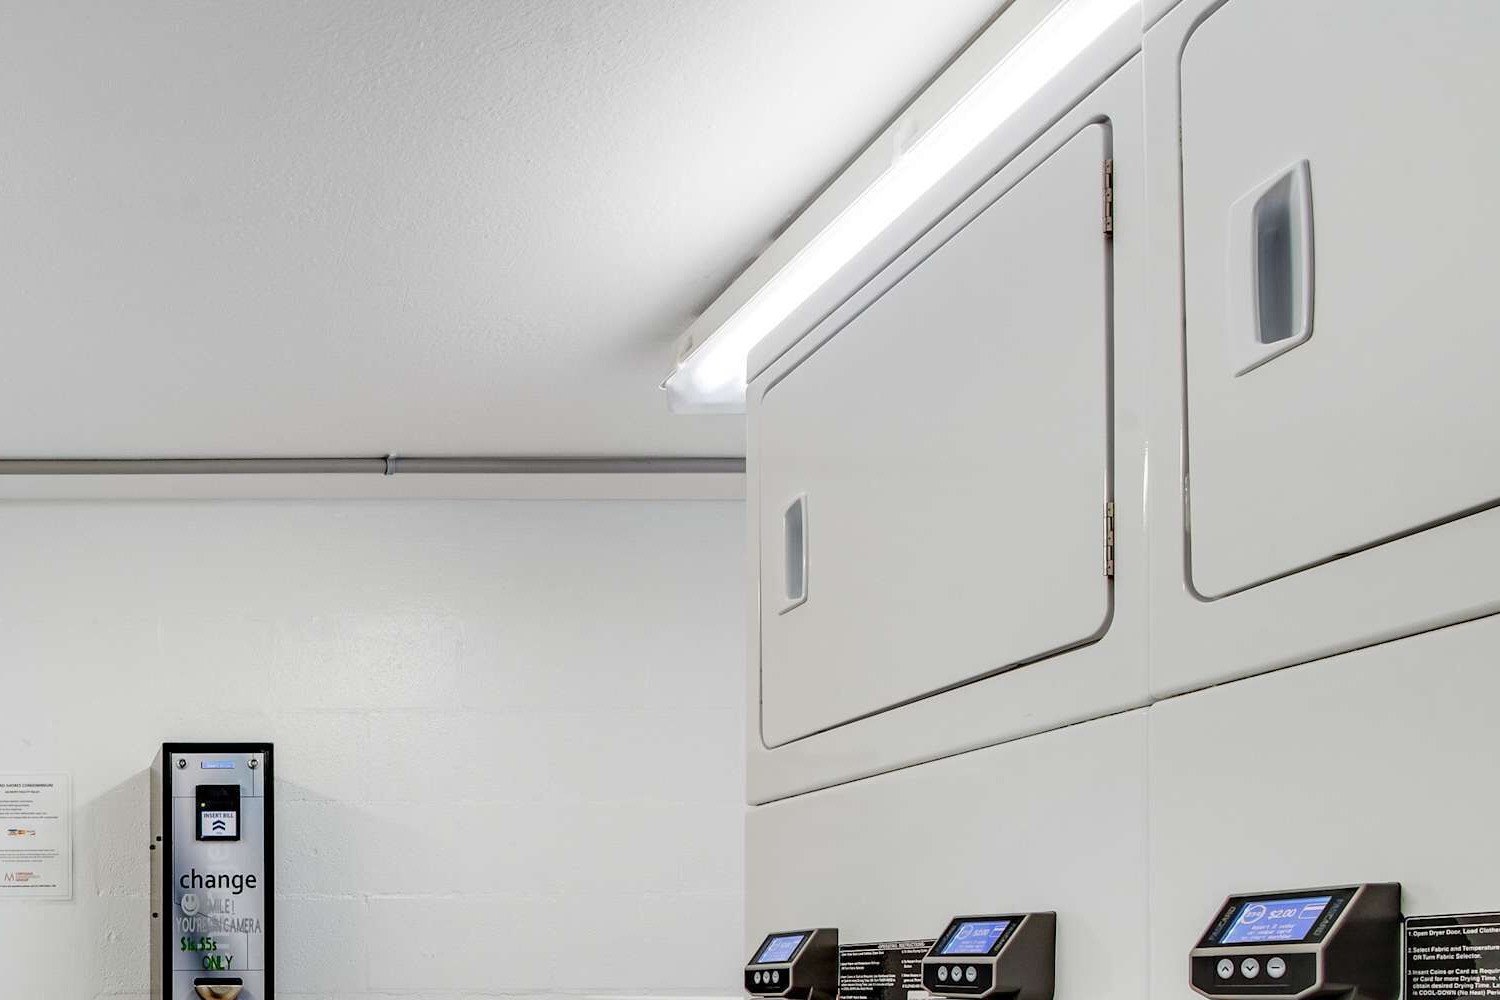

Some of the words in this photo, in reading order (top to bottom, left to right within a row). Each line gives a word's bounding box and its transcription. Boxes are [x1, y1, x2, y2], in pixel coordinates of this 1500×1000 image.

[180, 868, 257, 895] change
[223, 918, 262, 933] CAMERA
[1413, 930, 1429, 938] Open
[1429, 929, 1446, 937] Dryer
[203, 955, 233, 970] ONLY
[1460, 975, 1480, 983] Drying
